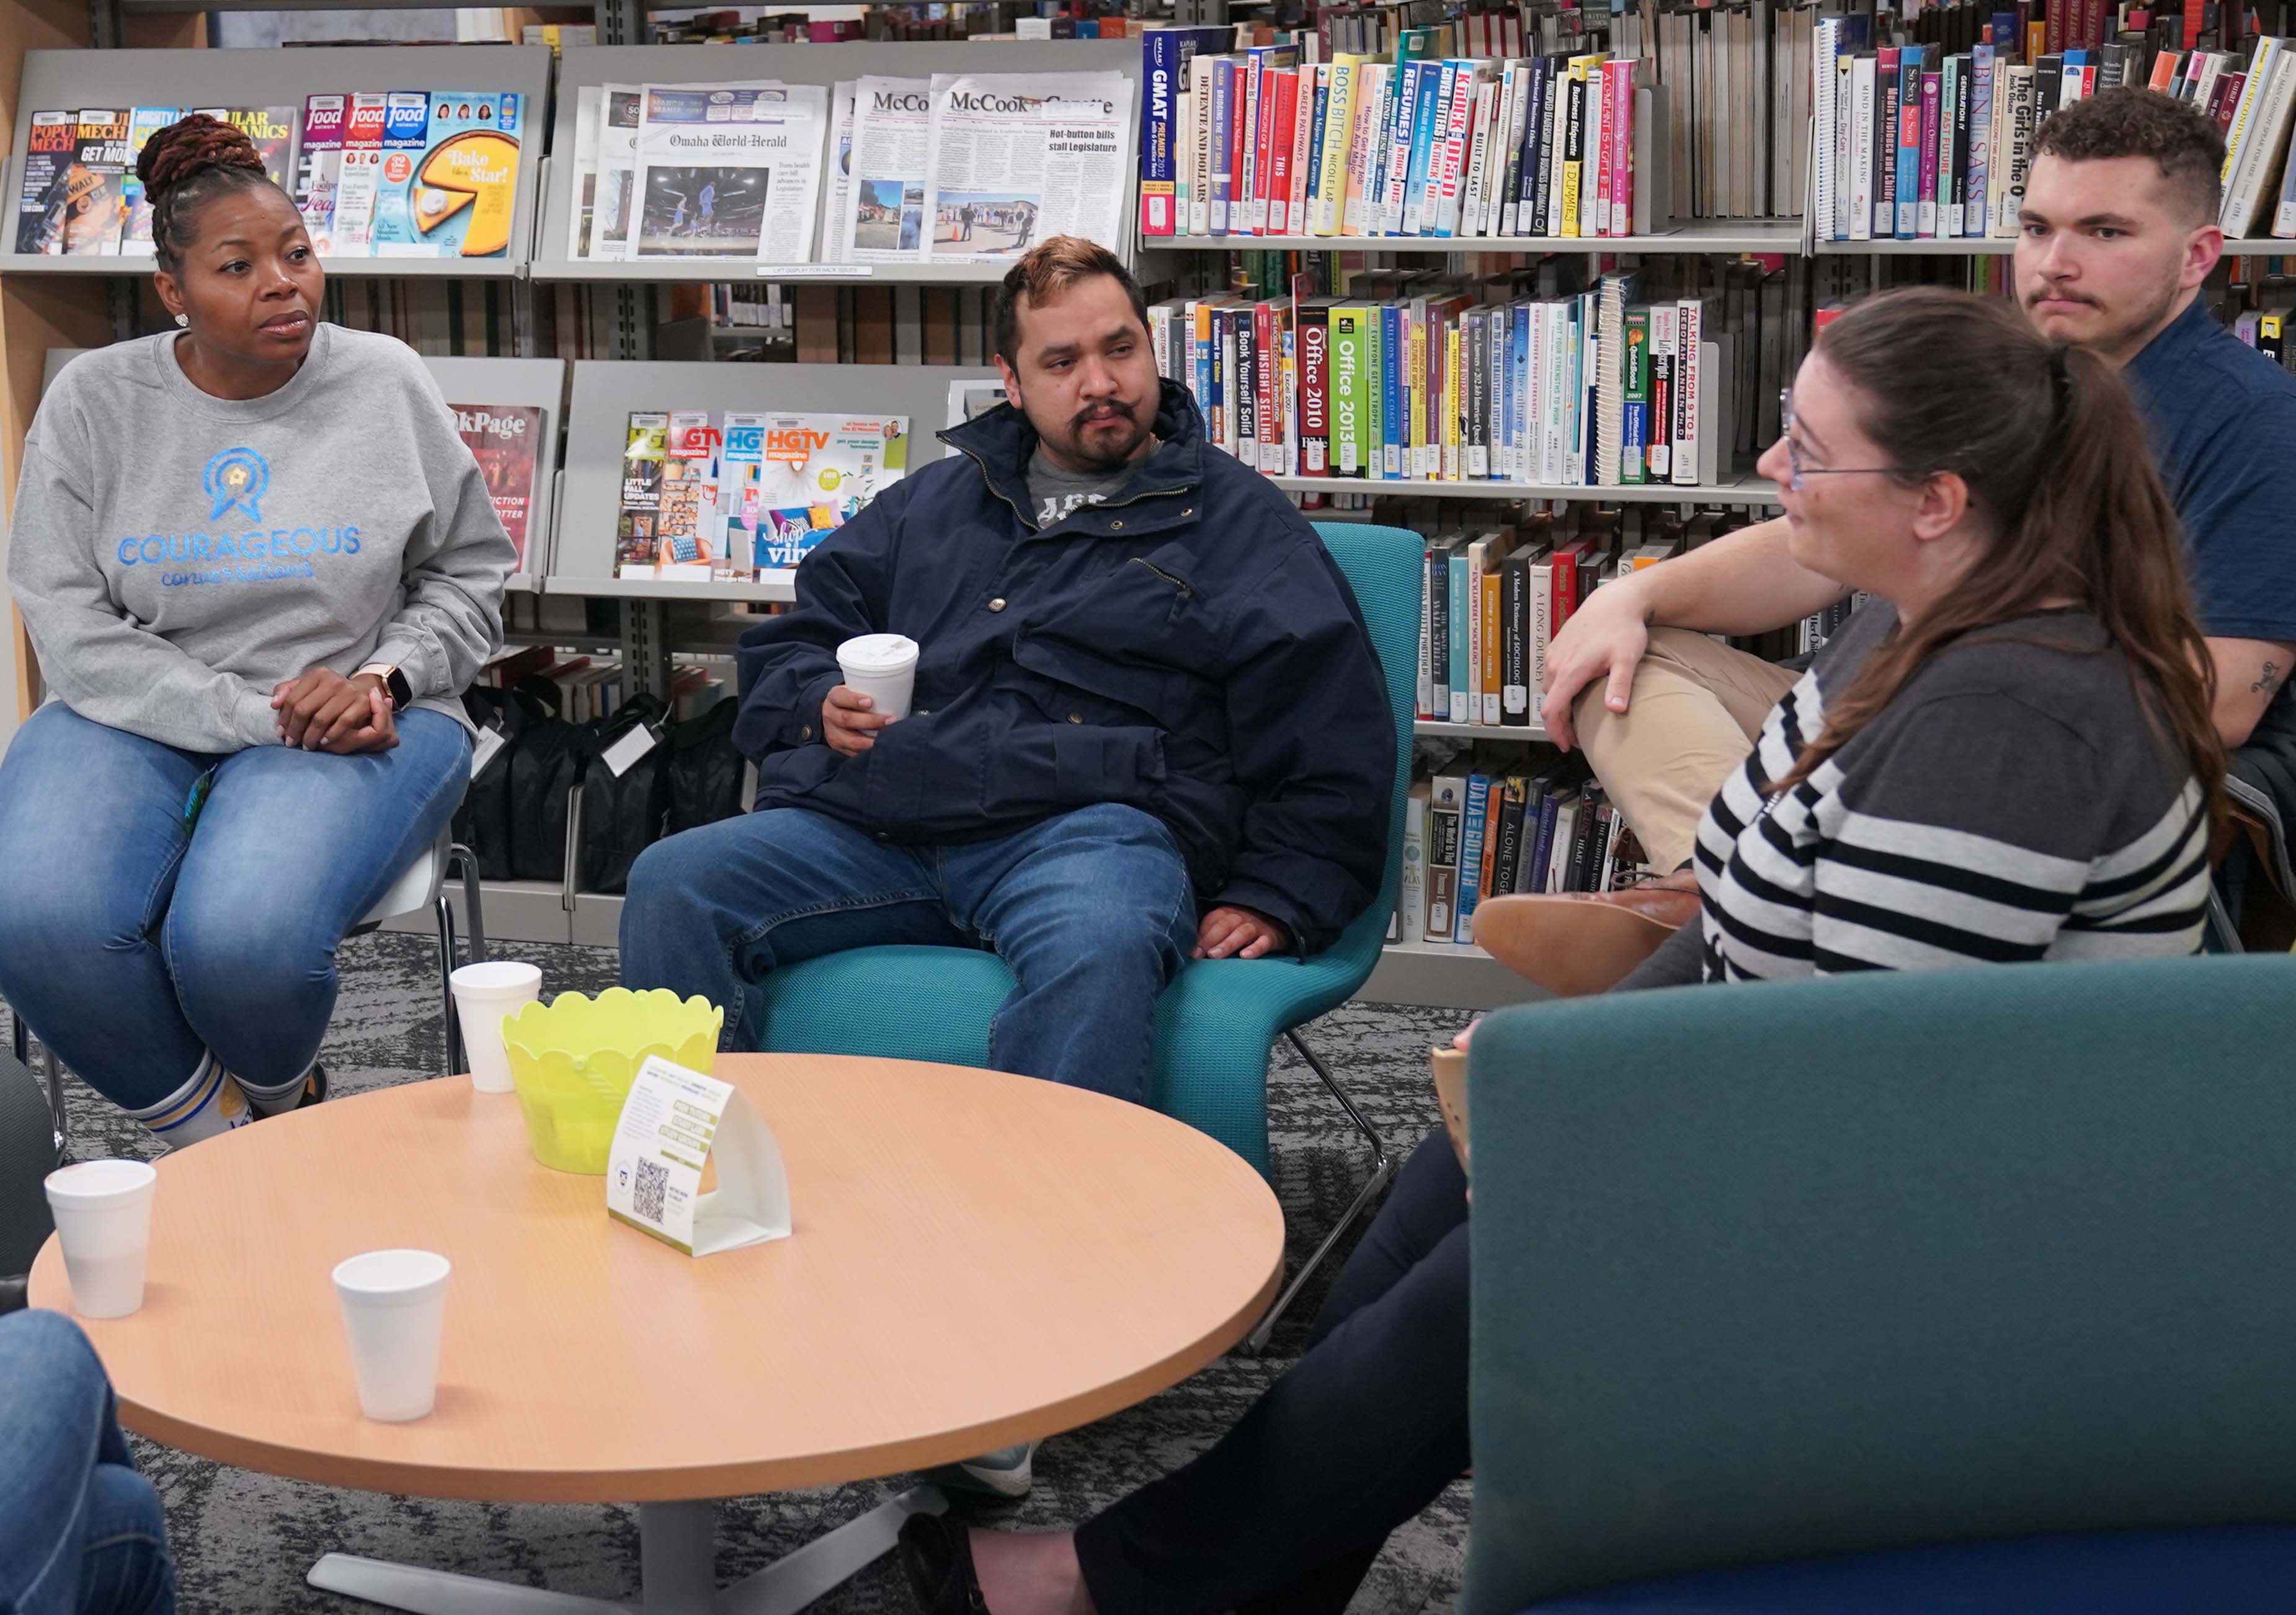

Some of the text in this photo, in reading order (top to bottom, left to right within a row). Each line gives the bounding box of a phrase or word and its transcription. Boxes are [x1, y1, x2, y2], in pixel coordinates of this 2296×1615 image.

[1604, 73, 1611, 81] A
[951, 92, 1026, 113] McCook
[1152, 70, 1167, 119] GMAT
[1317, 88, 1325, 116] College
[1399, 68, 1415, 137] RESUMES
[1434, 67, 1453, 136] COVER LETTERS
[1602, 83, 1611, 129] COMPLAINT
[1905, 69, 1916, 142] So Sexy So Soon
[306, 107, 344, 131] food
[349, 105, 385, 129] food
[387, 104, 427, 128] food
[1328, 66, 1350, 149] BOSS BITCH
[1528, 69, 1541, 148] Behavioral Business Ethics
[1861, 113, 1868, 122] IN
[2227, 69, 2261, 159] THE SECOND WAVE
[1314, 117, 1322, 142] Majors
[1363, 125, 1369, 135] to
[1569, 86, 1580, 156] Business Etiquette
[2247, 79, 2285, 177] MAN CANNOT SPEAK FOR HER
[303, 140, 342, 149] magazine
[385, 138, 425, 148] magazine
[670, 134, 786, 148] Omaha World-Herald
[1050, 129, 1094, 139] Hot-button
[1097, 130, 1115, 140] bills
[1351, 133, 1360, 148] Any
[1602, 131, 1610, 141] IS
[1941, 111, 1952, 174] FAST FUTURE
[447, 149, 489, 166] Bake
[1049, 143, 1117, 153] stall Legislature
[1536, 80, 1555, 216] PRINCIPLED LEADERSHIP AND BUSINESS DIPLOMACY
[1275, 156, 1285, 176] THIS
[1310, 159, 1319, 186] Careers
[1350, 151, 1359, 175] Major
[1358, 153, 1367, 168] Any
[1470, 132, 1484, 197] BUILT TO LAST
[1601, 151, 1609, 172] GIFT
[469, 167, 508, 182] Star!
[1357, 171, 1365, 185] Job
[1565, 171, 1577, 221] DUMMIES
[1557, 310, 1563, 319] GO
[1689, 308, 1697, 361] TALKING
[1306, 327, 1323, 388] Office
[1629, 346, 1638, 389] QuickBooks
[1239, 331, 1251, 434] Book Yourself Solid
[1339, 340, 1355, 442] Office 2013
[1258, 349, 1270, 441] INSIGHT SELLING
[1554, 396, 1559, 404] TO
[1307, 388, 1322, 428] 2010
[1687, 414, 1694, 430] TO
[767, 430, 830, 450] HGTV
[670, 448, 708, 458] magazine
[768, 450, 807, 460] magazine
[625, 478, 652, 486] LITTLE
[624, 493, 659, 501] UPDATES
[118, 526, 360, 565] COURAGEOUS
[763, 522, 818, 545] shop
[162, 560, 314, 586] conversations
[1441, 653, 1447, 662] OF
[1536, 636, 1544, 683] JOURNEY
[1467, 783, 1487, 815] DATA
[1447, 816, 1456, 826] The
[1467, 819, 1483, 828] AND
[1539, 804, 1551, 852] Charles Handy
[1446, 827, 1455, 844] World
[1445, 852, 1454, 863] Flat
[1462, 830, 1482, 887] GOLIATH
